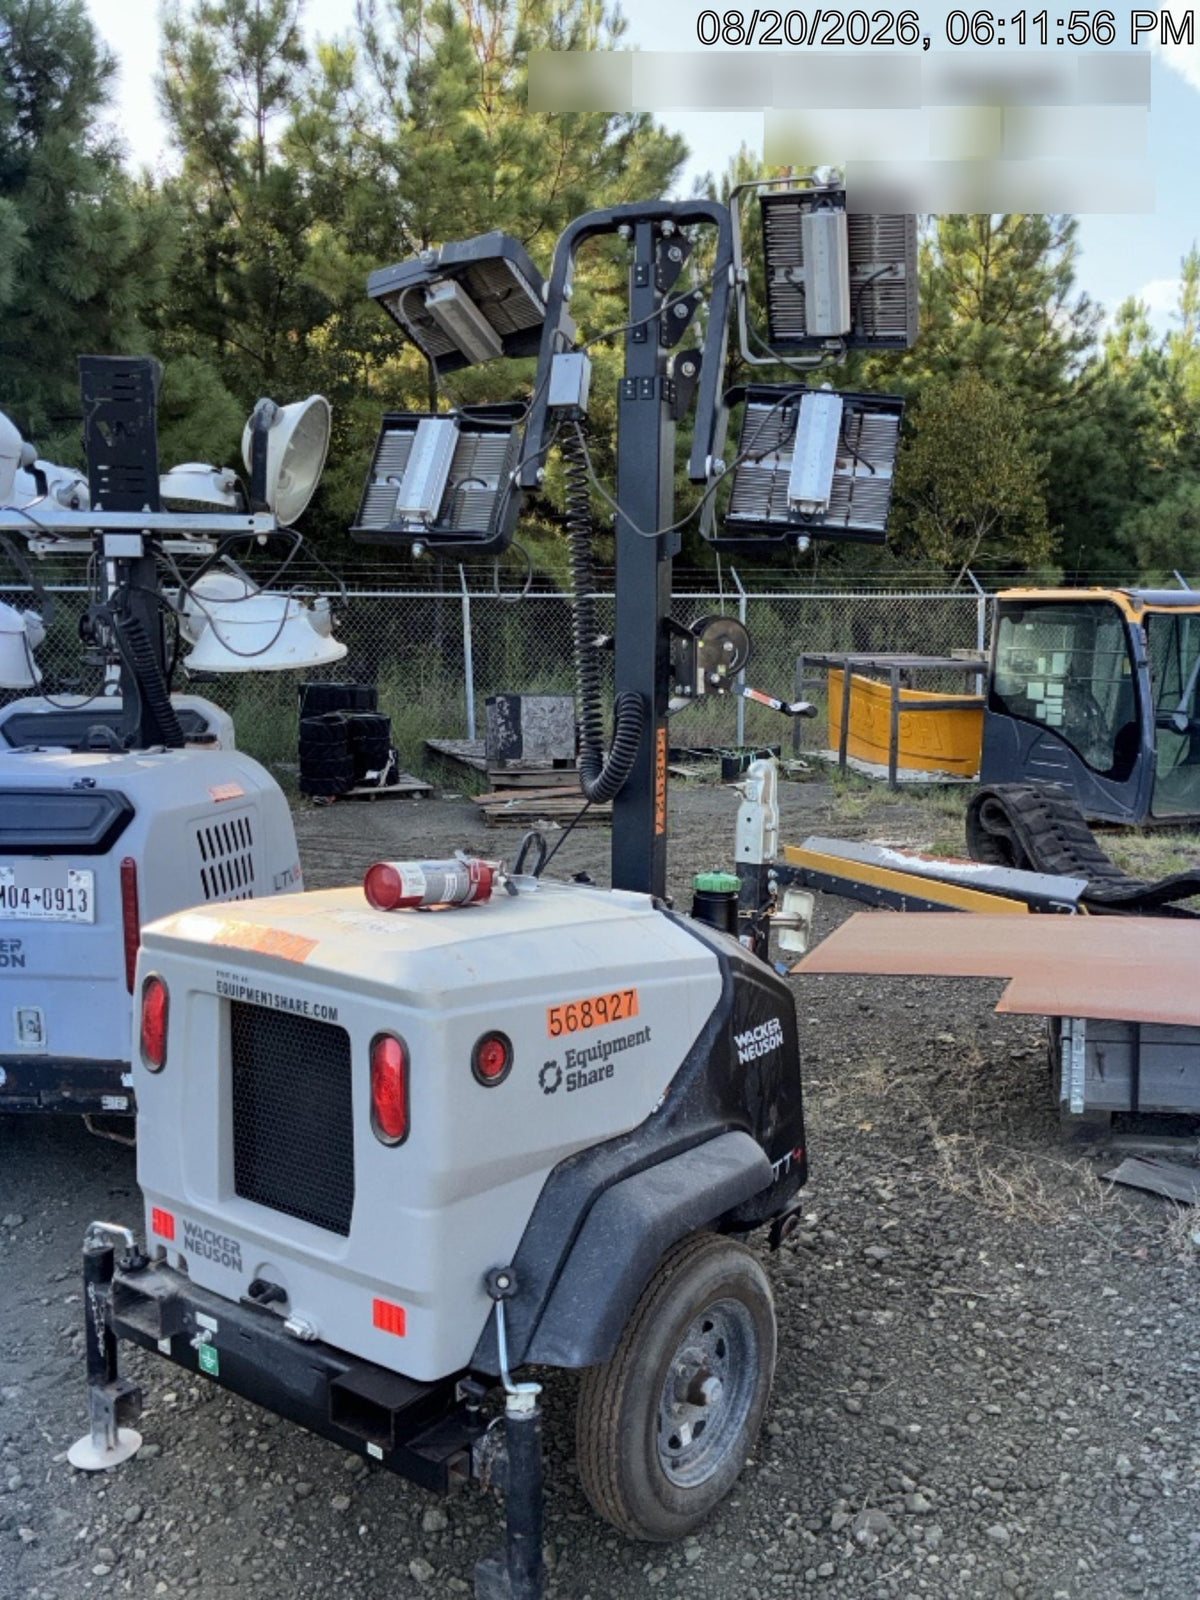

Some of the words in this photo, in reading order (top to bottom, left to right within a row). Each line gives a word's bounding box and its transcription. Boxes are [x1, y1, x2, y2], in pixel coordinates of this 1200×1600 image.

[216, 980, 339, 1021] EQUIPMENTSHARE.COM
[550, 989, 635, 1037] 568927
[564, 1025, 652, 1069] Equipment
[733, 1017, 782, 1049] WACKER
[738, 1030, 784, 1064] NEUSON
[565, 1062, 615, 1093] Share
[183, 1219, 241, 1256] WACKER
[183, 1235, 243, 1274] NEUSON
